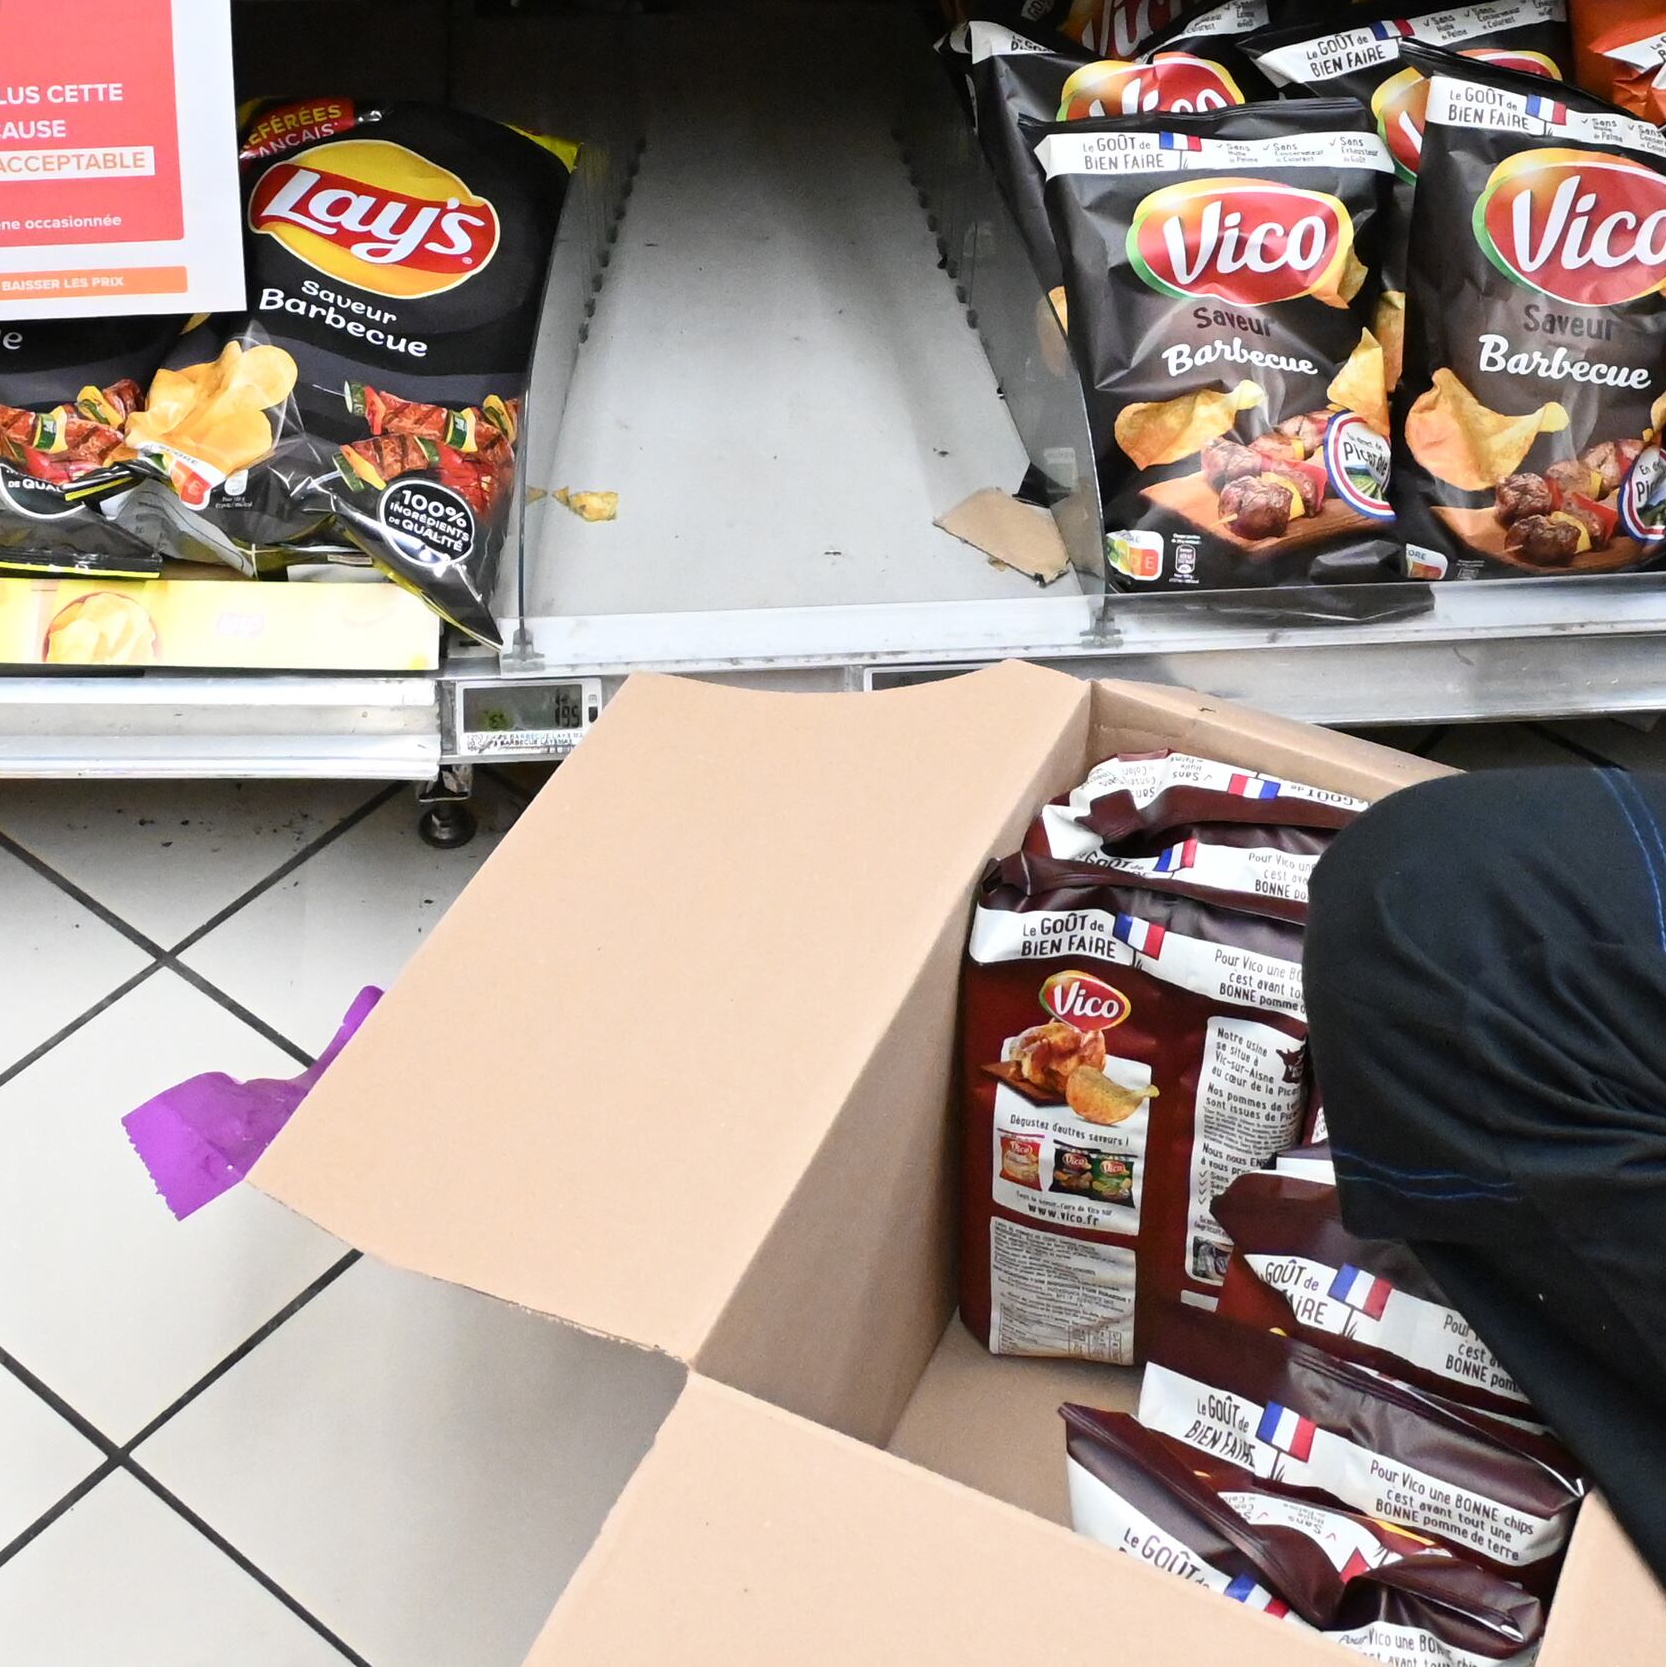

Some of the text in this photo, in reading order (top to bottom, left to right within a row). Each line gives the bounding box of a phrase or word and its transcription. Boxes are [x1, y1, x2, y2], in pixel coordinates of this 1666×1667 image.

[47, 83, 123, 103] CETTE
[1465, 85, 1505, 107] GOÛT
[25, 214, 122, 230] occasionnée
[262, 170, 485, 265] Lay's
[1164, 201, 1326, 286] Vico
[2, 279, 60, 292] BAISSER
[64, 277, 89, 289] LES
[92, 275, 124, 287] PRIX
[303, 279, 397, 325] Saveur
[259, 287, 429, 359] Barbecue
[1193, 307, 1271, 337] Saveur
[1524, 303, 1619, 341] Saveur
[1162, 337, 1318, 376] Barbecue
[1479, 334, 1651, 389] Barbecue
[390, 502, 470, 541] INGRÉDIENTS
[401, 490, 467, 527] 100%
[402, 519, 463, 552] QUALITÉ
[1023, 913, 1105, 937] Le GOÛT de
[1052, 981, 1120, 1019] Vico
[1214, 1052, 1274, 1084] Vic-sur-Aisne
[1028, 1204, 1101, 1227] www.vico.fr
[1370, 1459, 1535, 1537] Pour Vico une BONNE chips
[1376, 1499, 1520, 1563] BONNE pomme de terre
[1418, 1497, 1454, 1520] avant
[1458, 1509, 1486, 1531] tout
[1489, 1526, 1512, 1544] une
